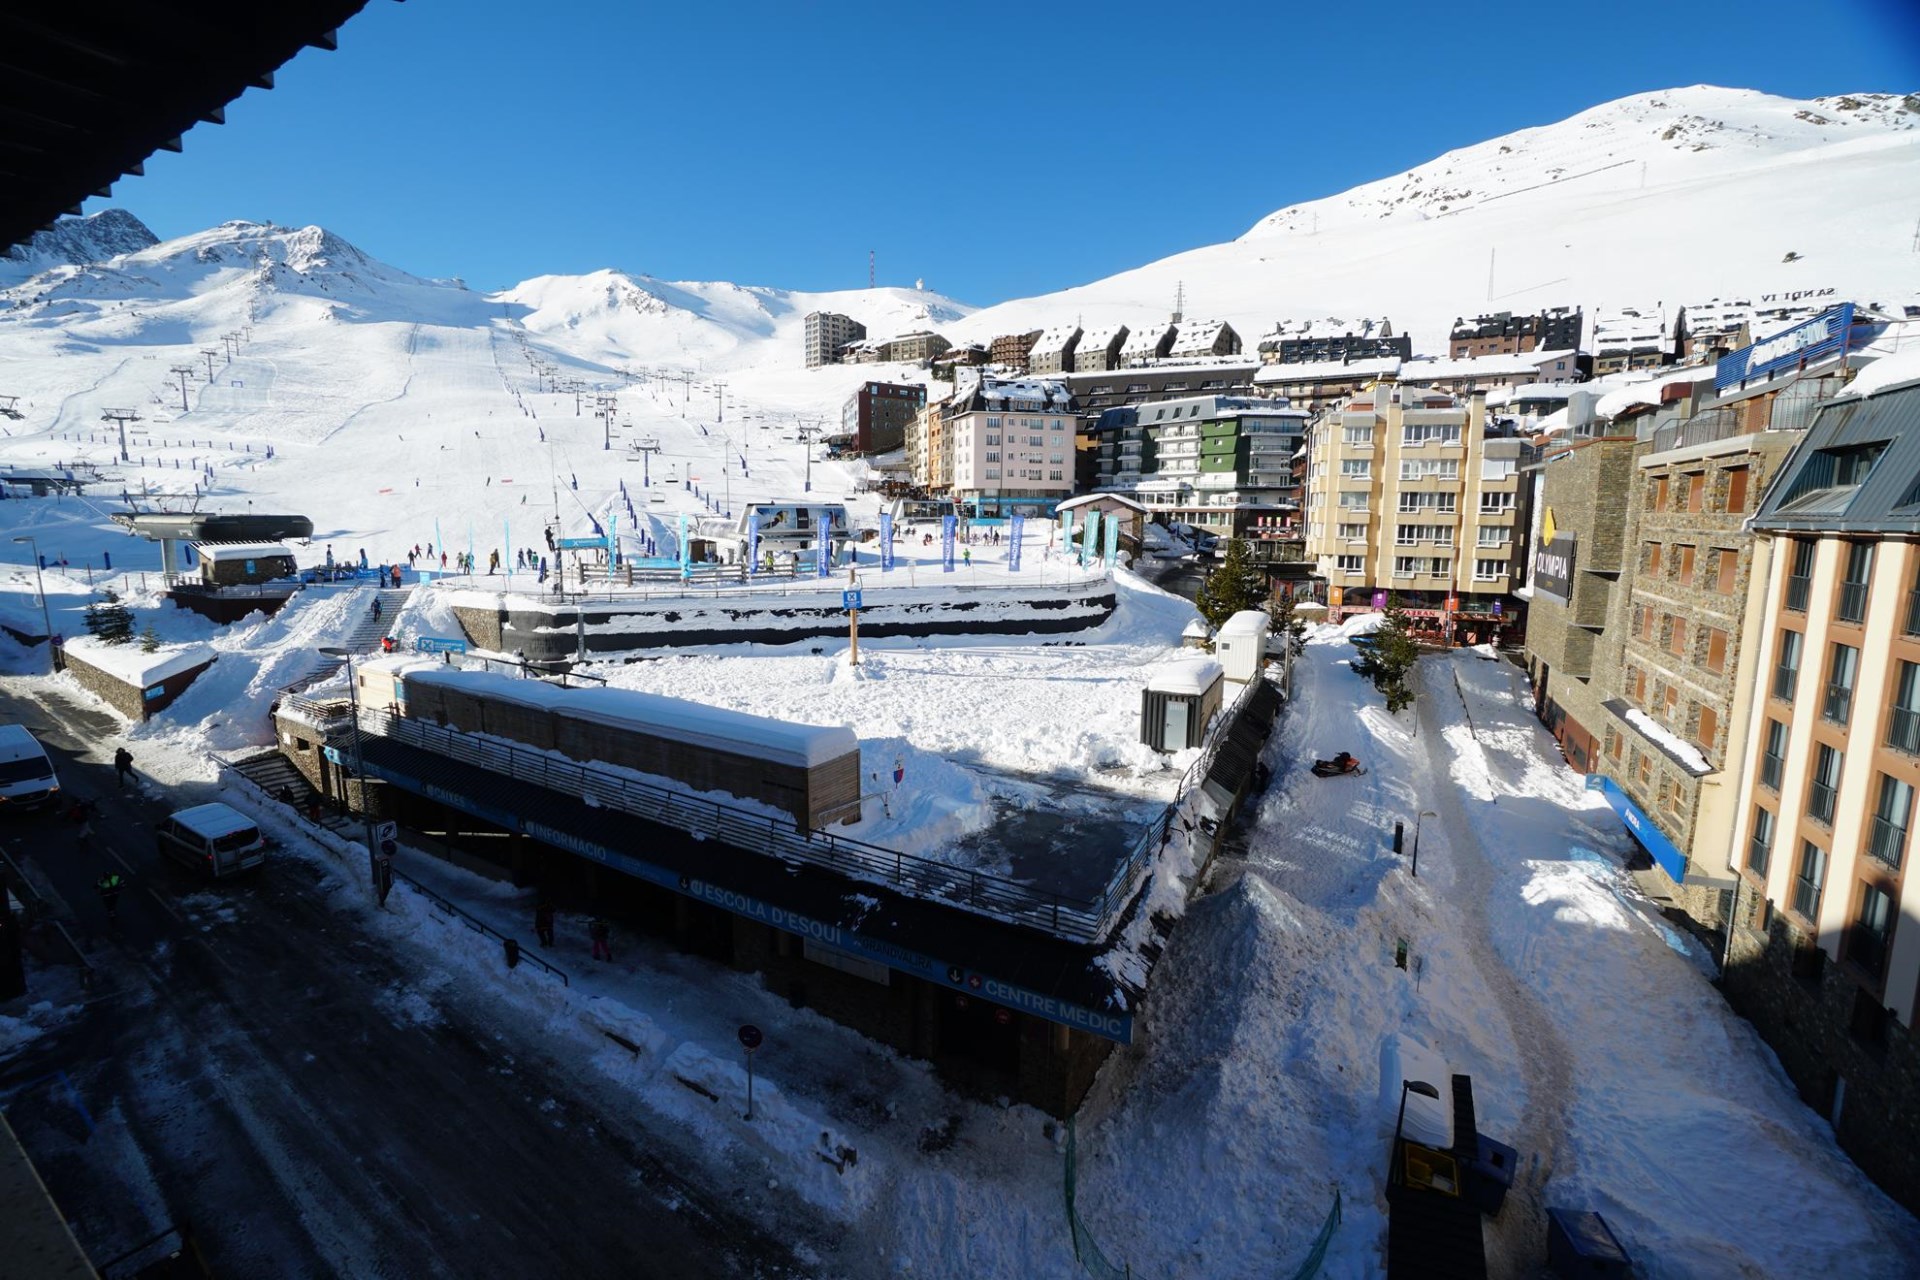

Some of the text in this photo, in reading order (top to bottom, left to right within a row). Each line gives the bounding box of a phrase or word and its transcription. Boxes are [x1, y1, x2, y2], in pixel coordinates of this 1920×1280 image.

[1536, 552, 1567, 580] OLYMPIA
[705, 884, 842, 945] ESCOLA D'ESQUI
[984, 979, 1122, 1036] CENTRE MEDIC
